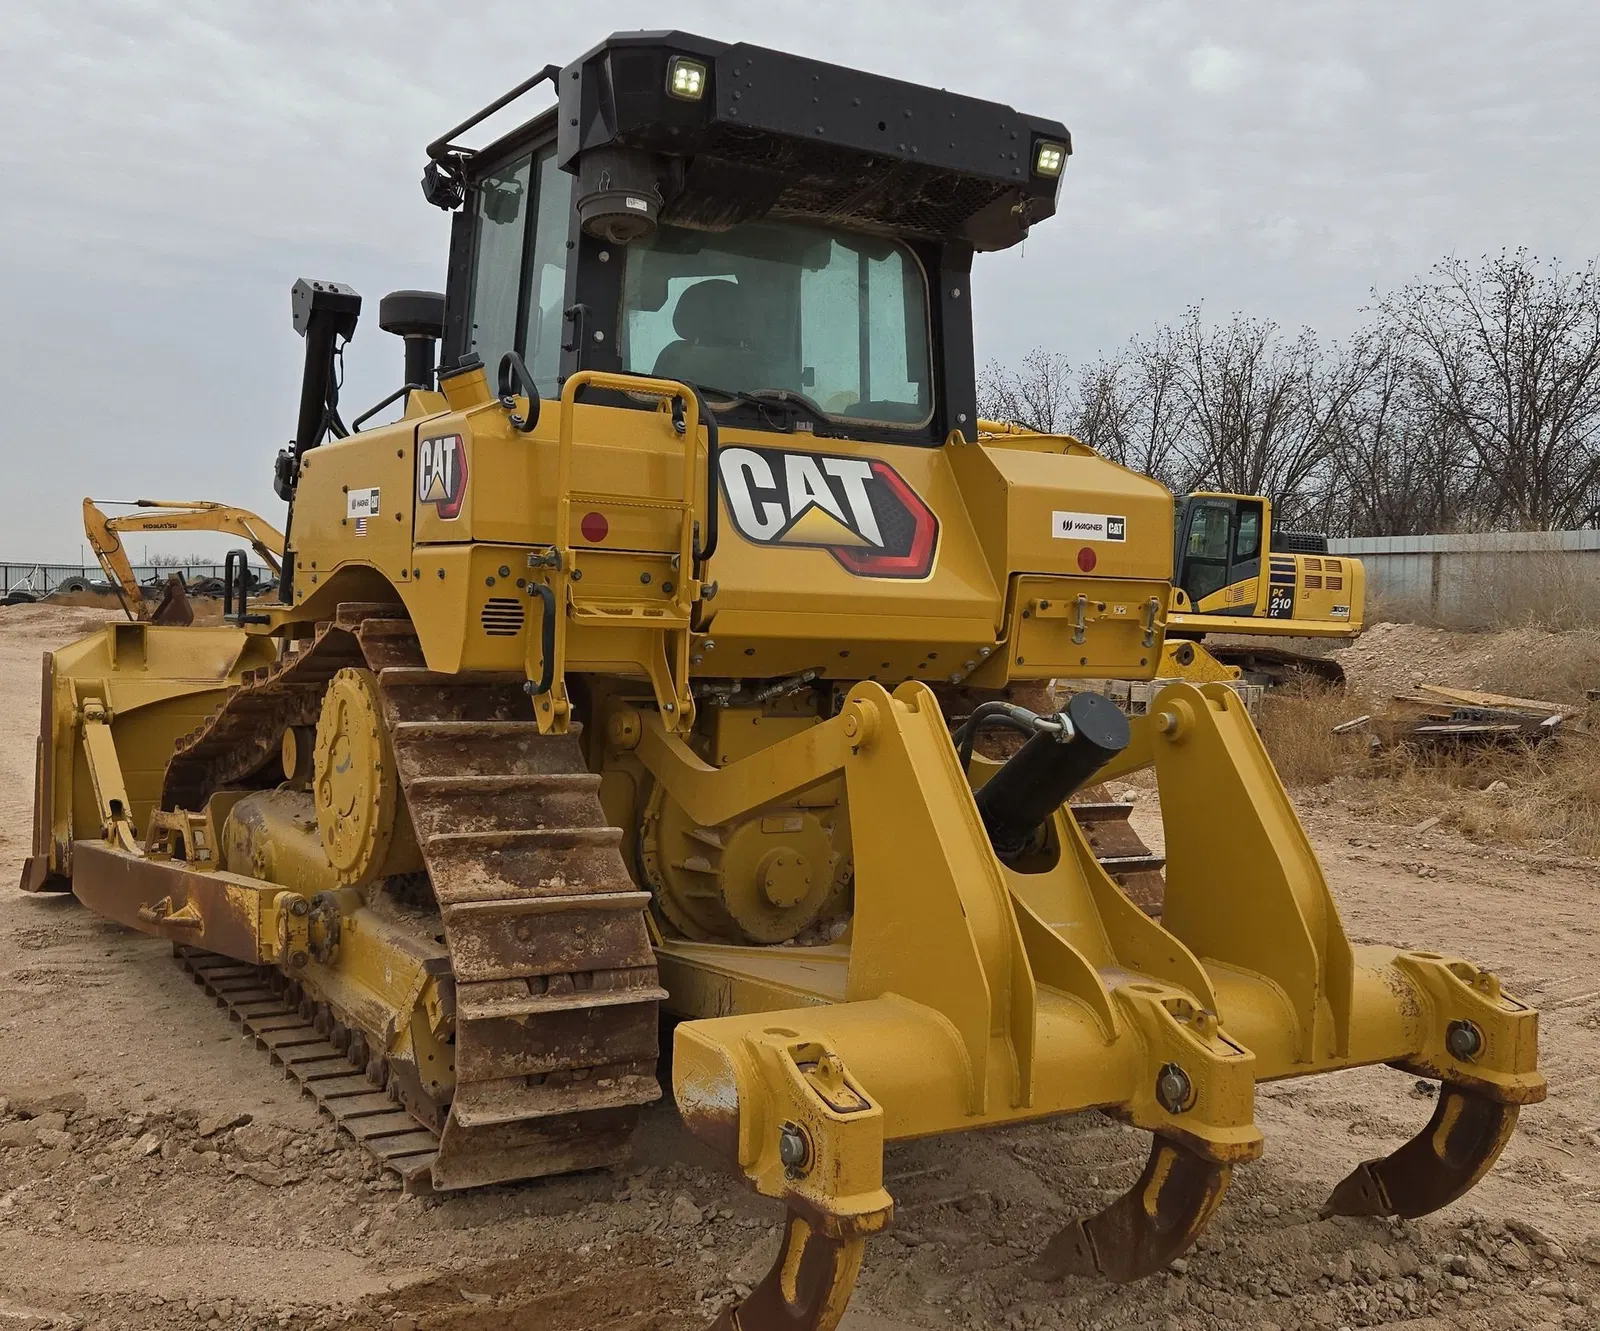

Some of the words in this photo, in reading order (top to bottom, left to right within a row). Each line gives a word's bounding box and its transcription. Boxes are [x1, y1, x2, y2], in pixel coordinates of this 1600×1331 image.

[420, 437, 456, 500] CAT
[719, 448, 885, 547] CAT
[1074, 523, 1103, 531] WAGNER
[1108, 523, 1123, 534] CAT
[1272, 588, 1284, 597] PC
[1270, 597, 1291, 609] 210
